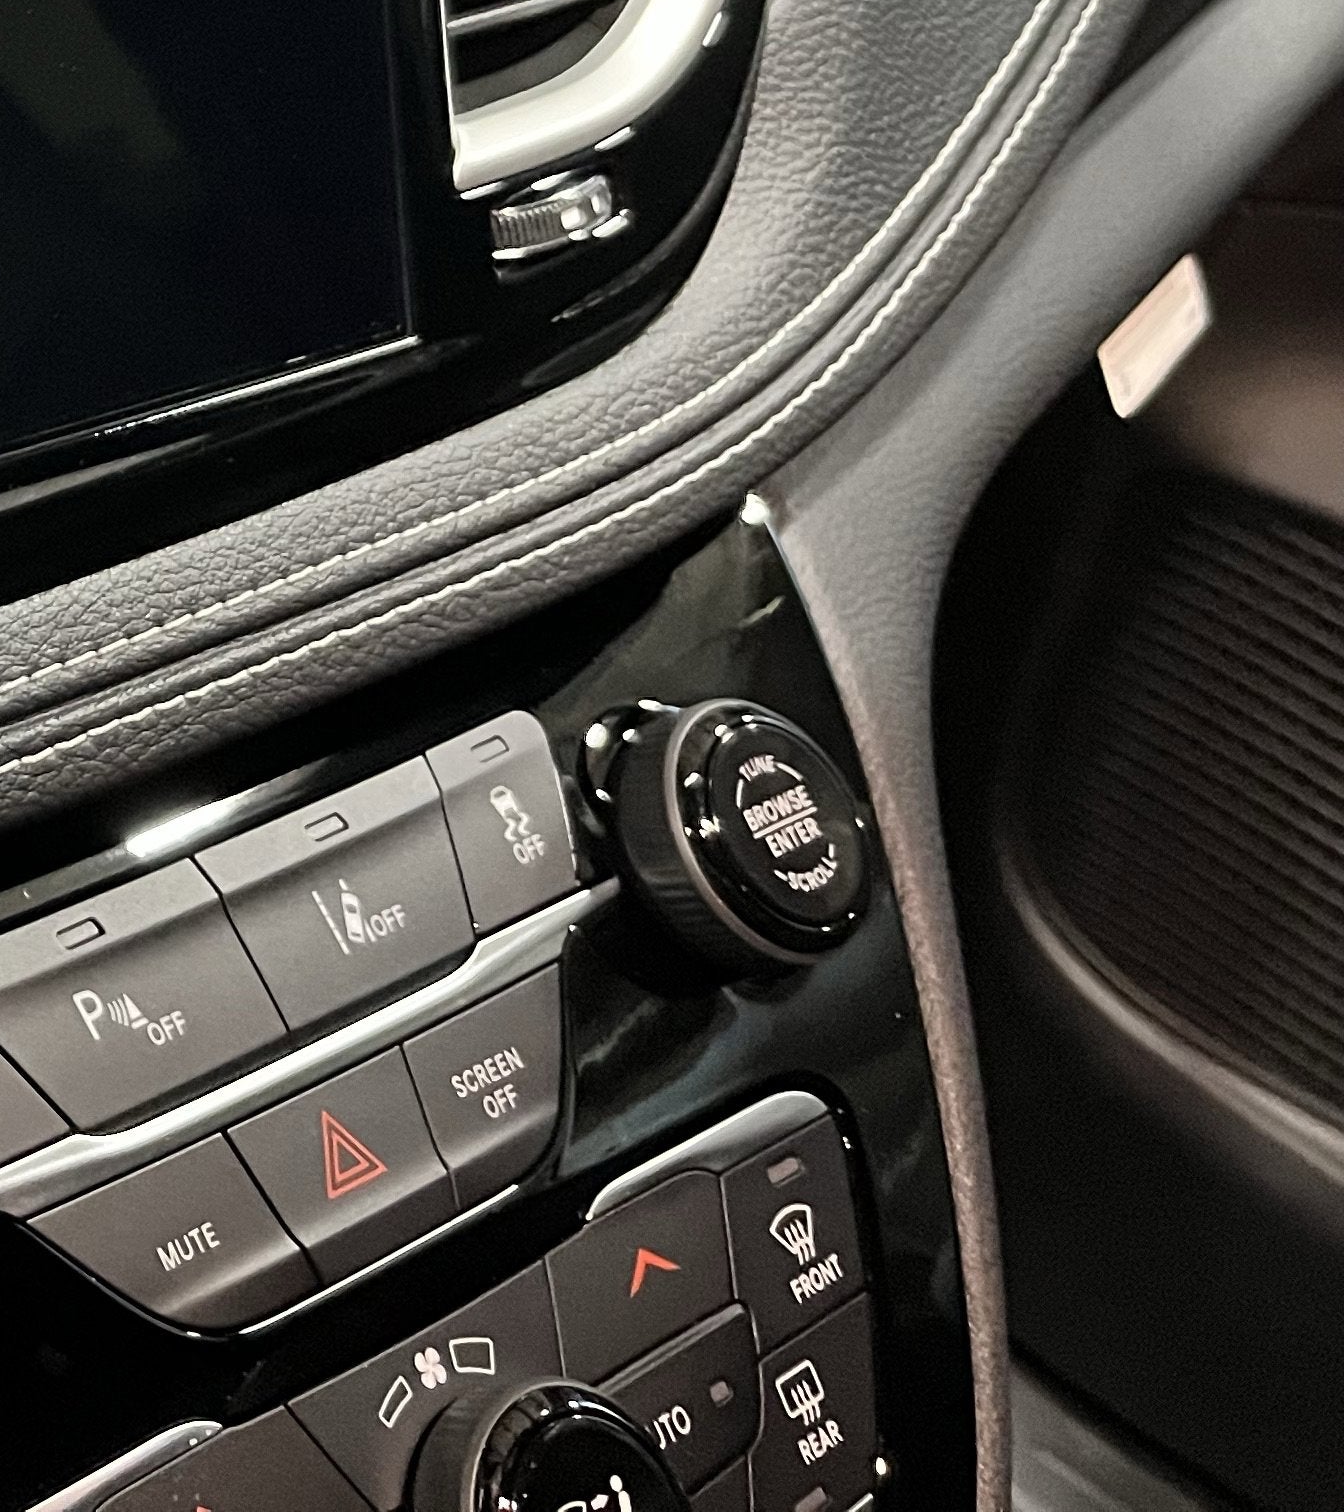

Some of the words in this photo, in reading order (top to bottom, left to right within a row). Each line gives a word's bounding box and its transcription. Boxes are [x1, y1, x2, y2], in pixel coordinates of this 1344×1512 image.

[739, 754, 778, 782] TUNE
[743, 785, 814, 832] BROWSE
[512, 833, 546, 865] OFF
[765, 817, 823, 858] ENTER
[786, 856, 838, 892] SCROLL
[371, 904, 407, 937] OFF
[72, 989, 103, 1041] P
[146, 1010, 186, 1046] OFF
[450, 1046, 525, 1099] SCREEN
[482, 1083, 519, 1119] OFF
[155, 1222, 220, 1272] MUTE
[789, 1252, 844, 1304] FRONT
[644, 1404, 692, 1450] UTO
[797, 1420, 845, 1466] REAR
